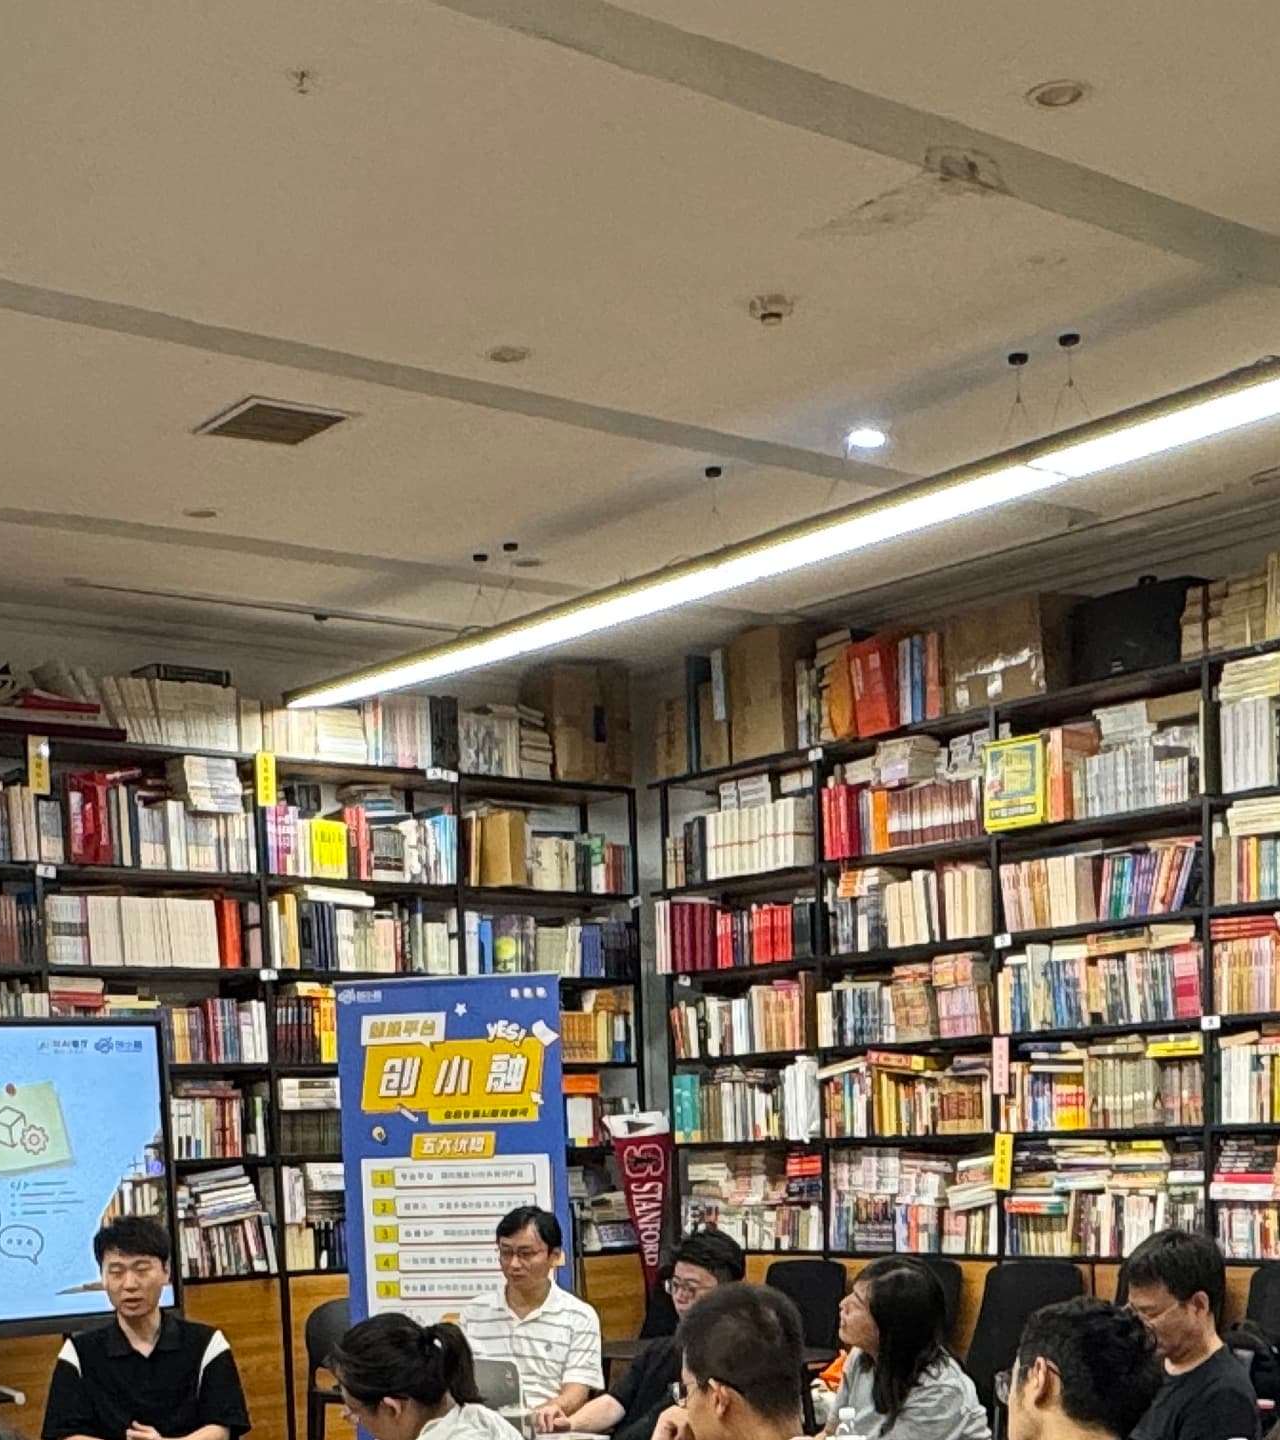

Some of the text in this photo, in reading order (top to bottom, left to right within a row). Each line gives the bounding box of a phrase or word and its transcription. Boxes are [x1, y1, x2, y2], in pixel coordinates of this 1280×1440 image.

[377, 1053, 528, 1098] 创小融
[631, 1180, 663, 1267] STANFORD
